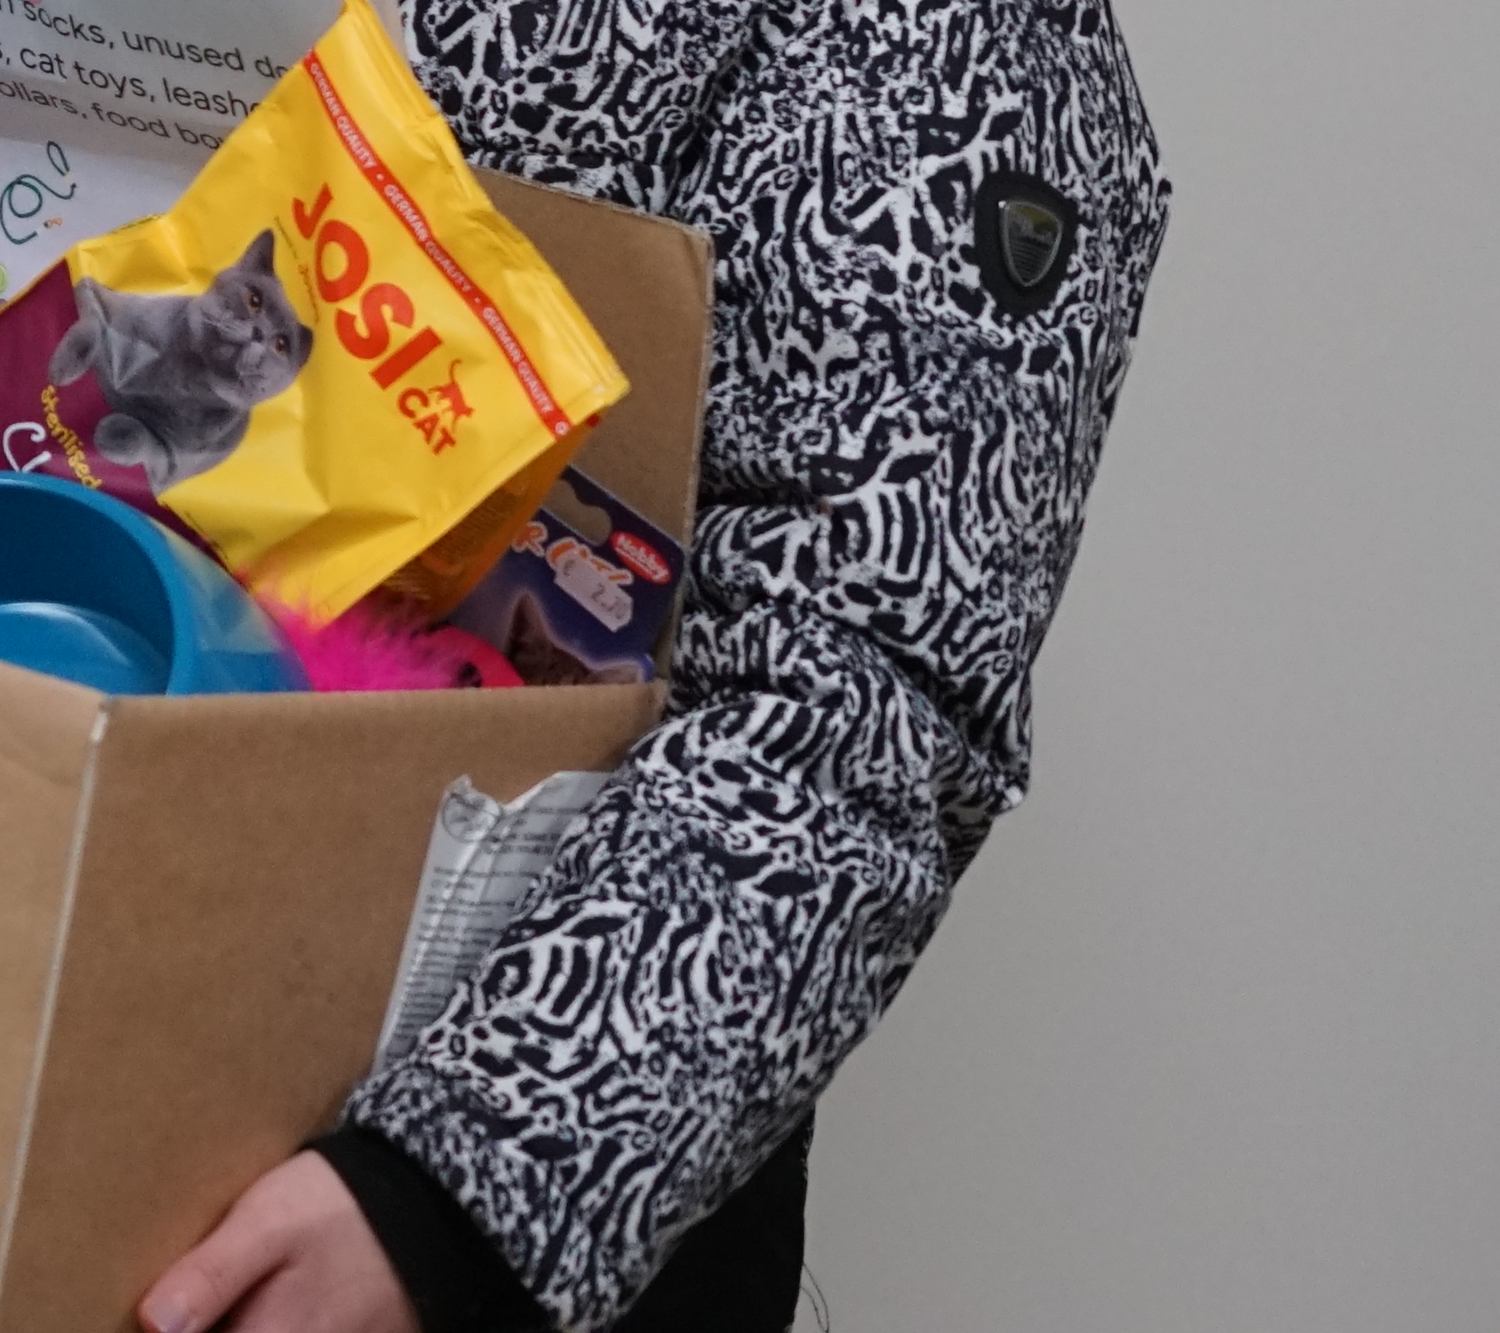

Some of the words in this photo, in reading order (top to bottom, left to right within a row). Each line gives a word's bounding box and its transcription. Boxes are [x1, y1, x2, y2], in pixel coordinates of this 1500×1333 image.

[24, 0, 114, 50] socks,
[123, 28, 243, 73] unused
[19, 47, 66, 81] cat
[74, 62, 157, 102] toys,
[163, 78, 260, 119] leash
[91, 103, 171, 141] food
[310, 62, 340, 117] GERMAN
[336, 115, 377, 169] QUALITY
[384, 184, 429, 242] GERMAN
[424, 240, 471, 291] QUALITY
[482, 306, 522, 363] GERMAN
[517, 361, 554, 413] QUALITY
[291, 182, 443, 391] JOSI
[41, 385, 102, 489] Sterilised
[397, 387, 458, 456] CAT
